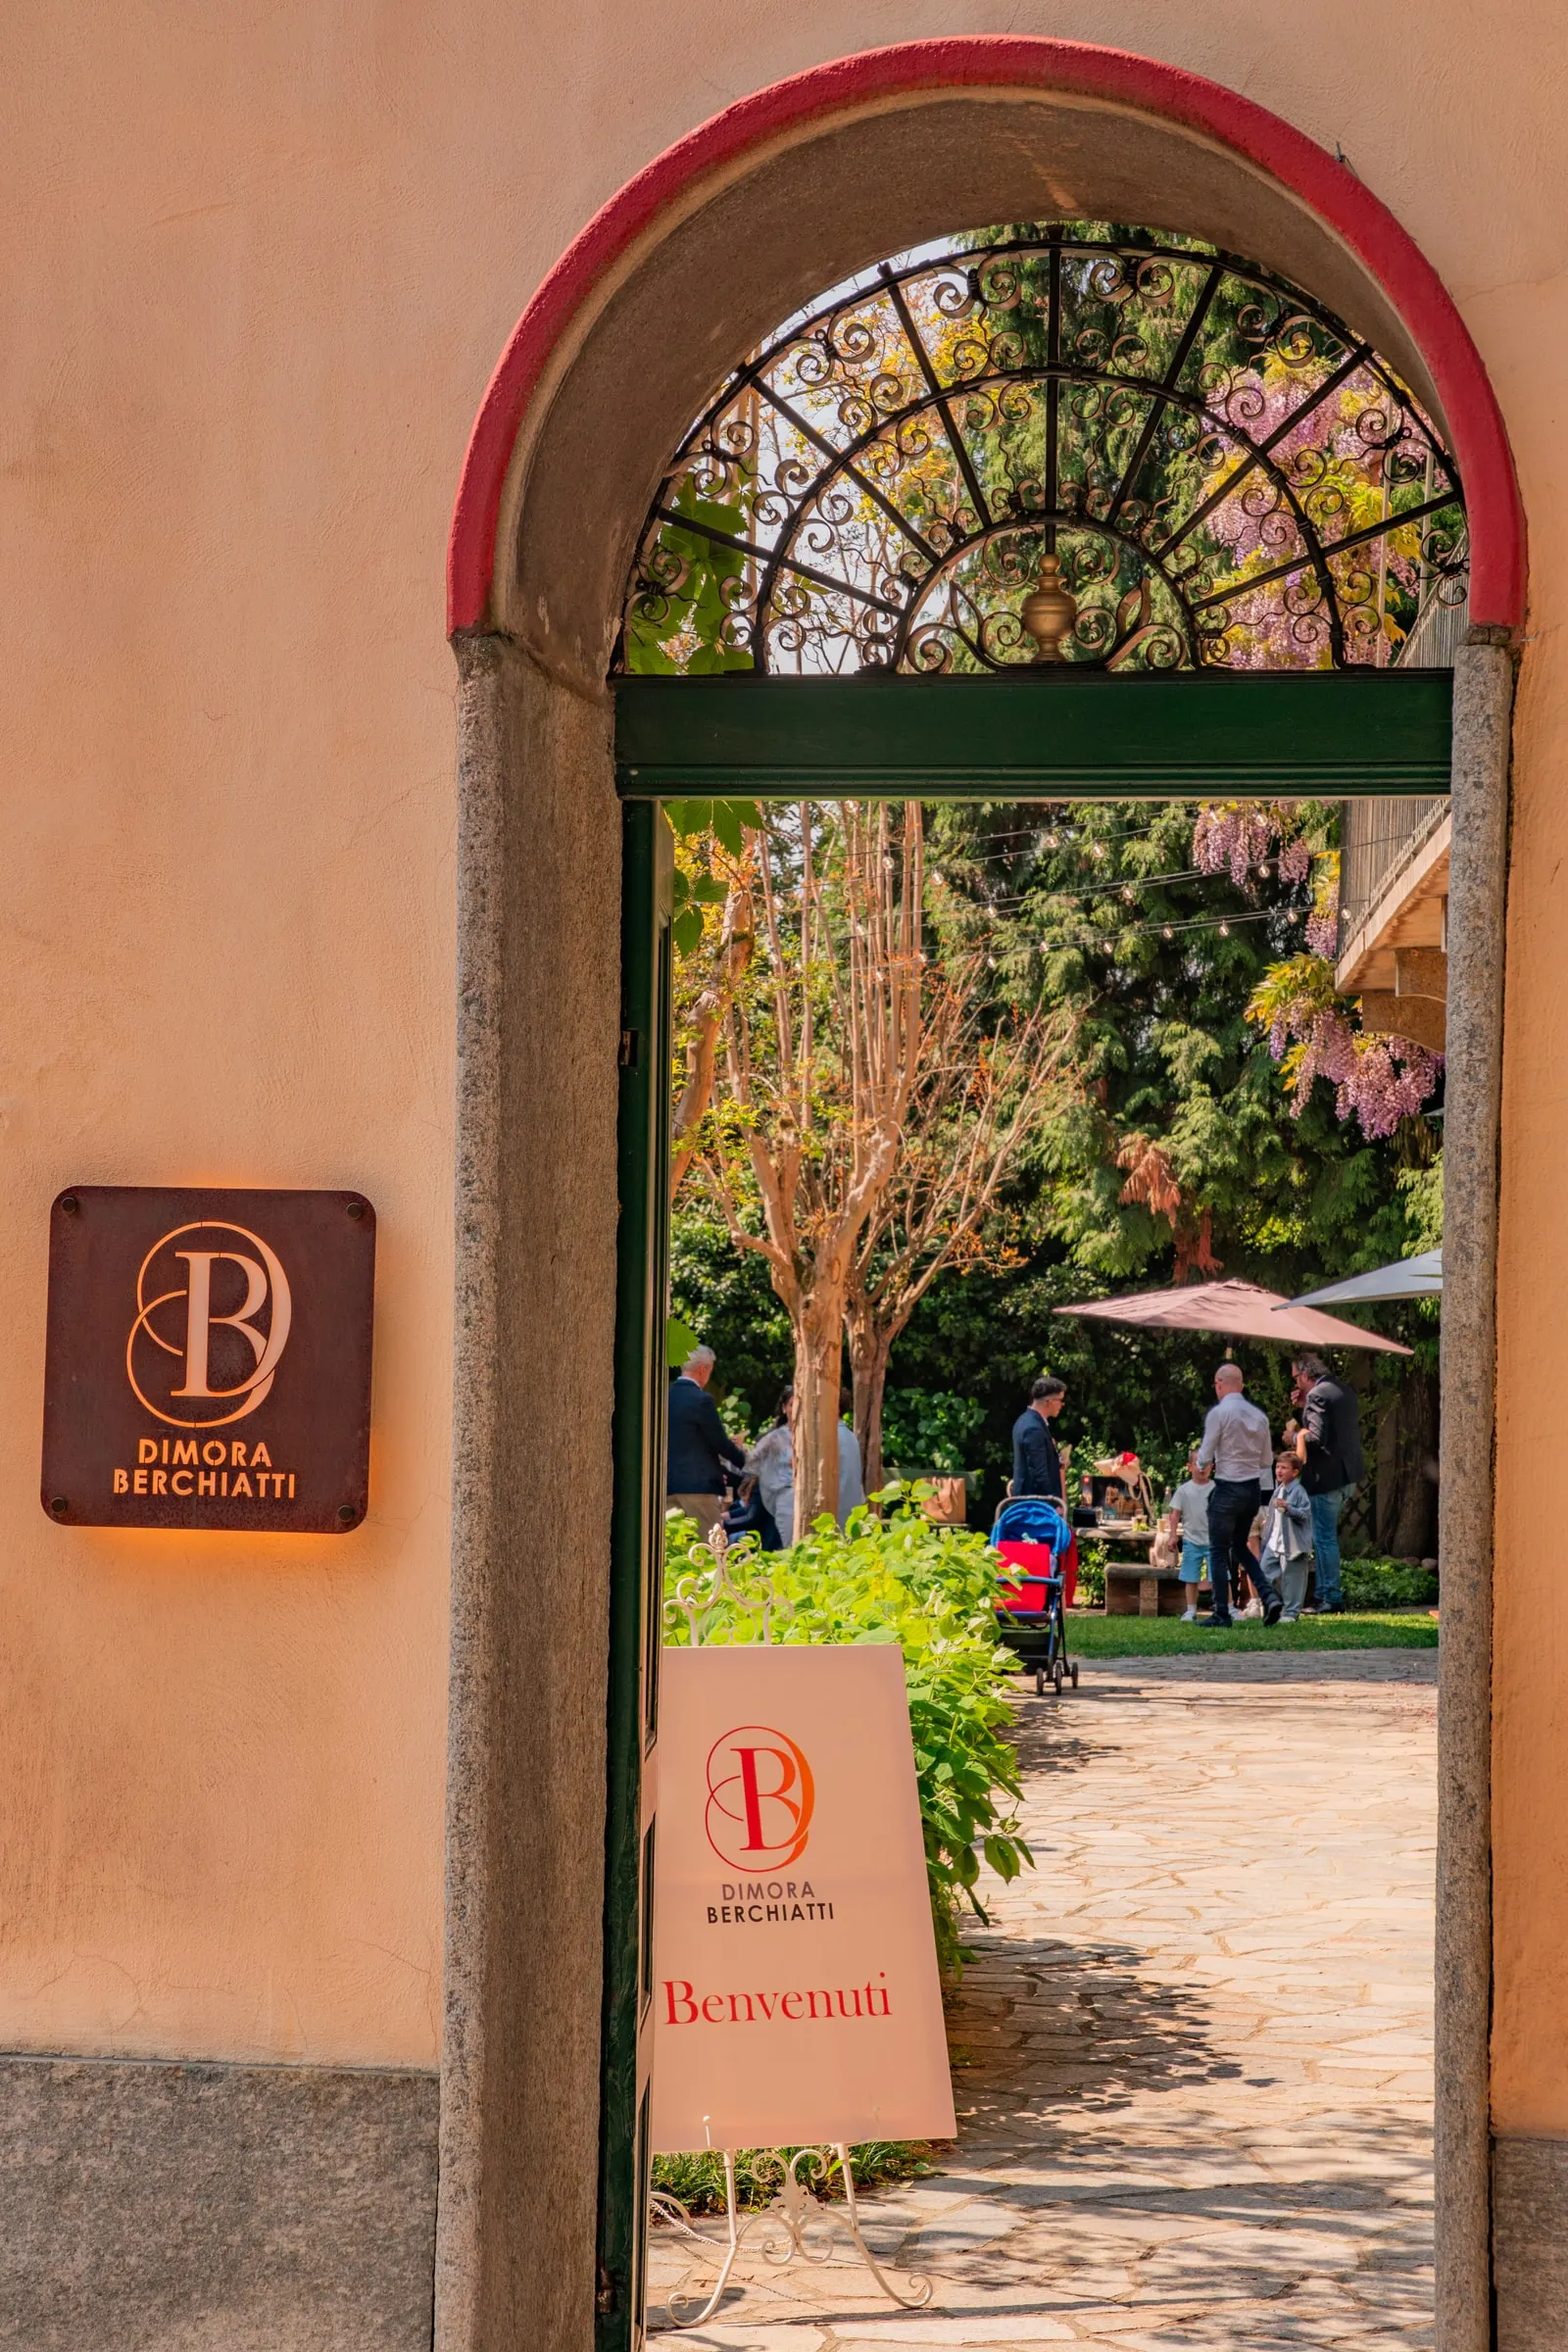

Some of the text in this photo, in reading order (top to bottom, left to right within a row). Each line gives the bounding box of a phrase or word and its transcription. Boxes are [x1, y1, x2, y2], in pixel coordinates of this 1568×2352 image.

[138, 1440, 272, 1467] DIMORA
[113, 1469, 295, 1498] BERCHIATTI
[721, 1882, 815, 1901] DIMORA
[707, 1902, 835, 1924] BERCHIATTI
[662, 1972, 893, 2026] Benvenuti
